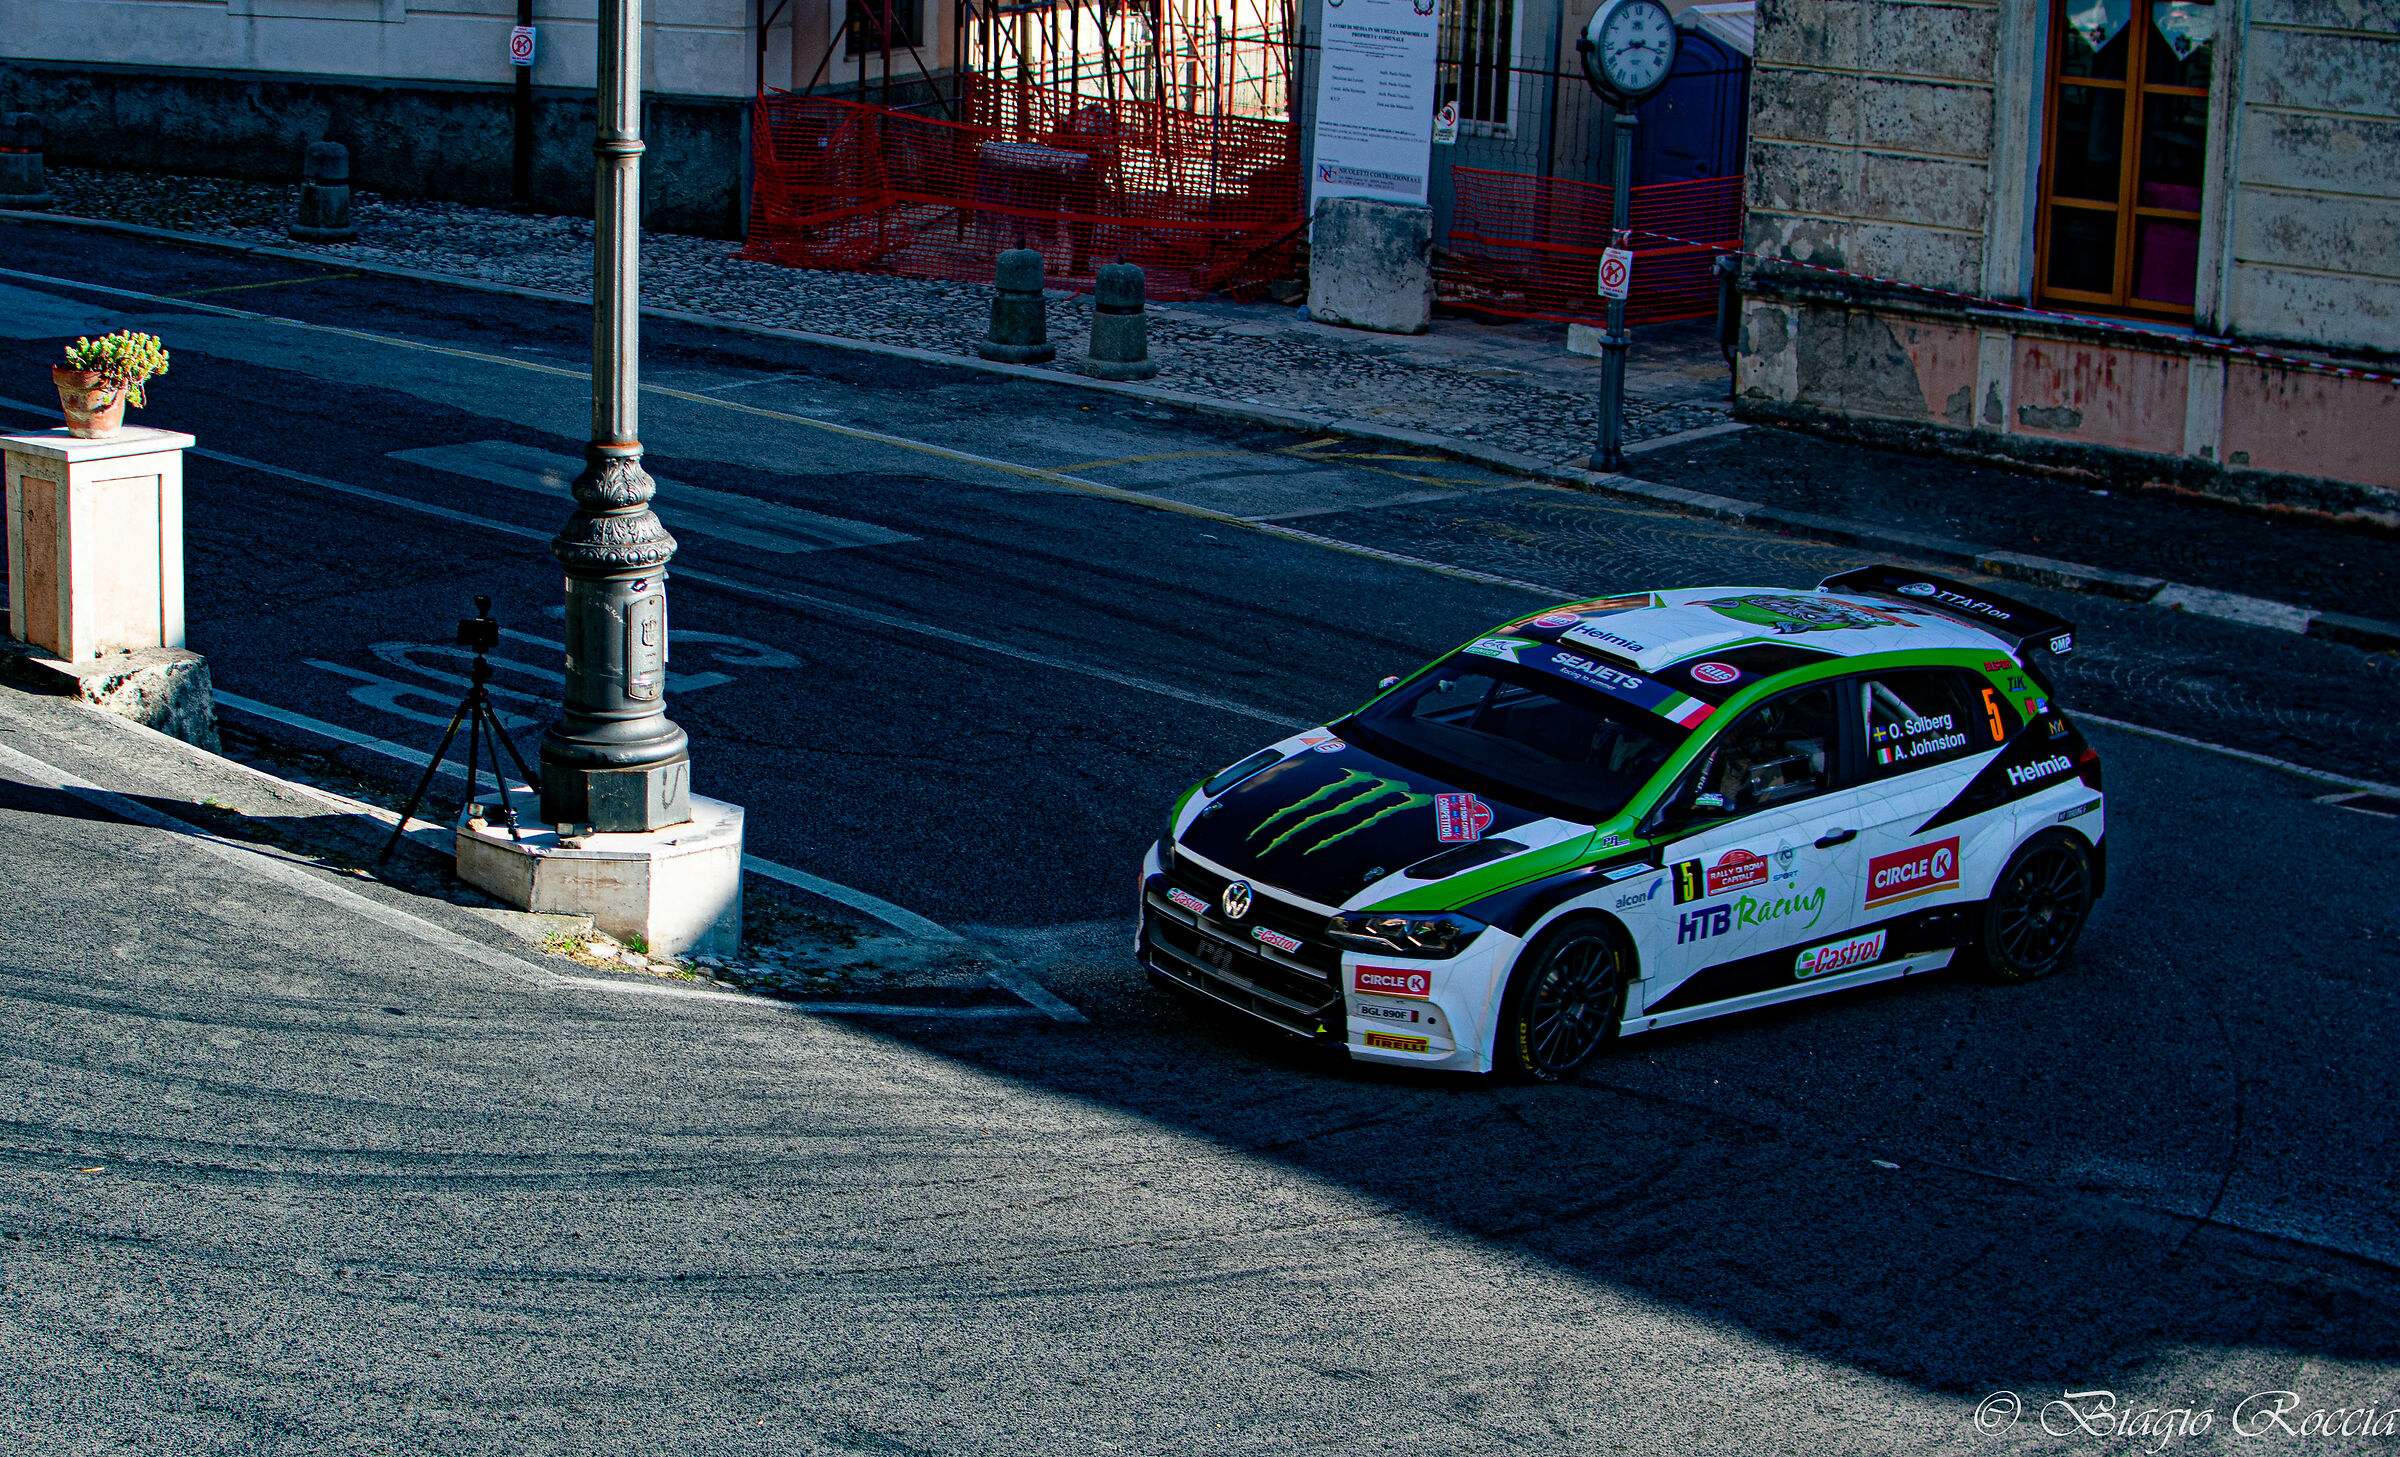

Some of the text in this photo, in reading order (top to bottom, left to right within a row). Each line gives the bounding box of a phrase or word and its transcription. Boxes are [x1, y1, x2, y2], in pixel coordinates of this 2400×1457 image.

[1573, 625, 1645, 653] Helmia
[2050, 636, 2072, 652] OMP
[1551, 652, 1643, 689] SEAJETS
[1560, 667, 1617, 692] Racing to summer
[1889, 713, 1953, 740] O. Solberg
[1981, 688, 2005, 742] 5
[1895, 732, 1967, 761] A. Johnston
[2007, 754, 2073, 786] Helmia
[1439, 797, 1452, 837] COMPETITOR
[1710, 868, 1734, 880] RALLY
[1744, 861, 1765, 873] ROMA
[1721, 871, 1755, 885] CAPITALE
[1772, 870, 1799, 882] SPORT
[1875, 848, 1952, 889] CIRCLE K
[1680, 862, 1694, 902] 5
[1174, 891, 1209, 913] Castrol
[1615, 893, 1647, 909] alcon
[1677, 882, 1827, 945] HTB Racing
[1260, 930, 1299, 952] Castrol
[1814, 935, 1881, 974] Castrol
[1360, 973, 1426, 992] CIRCLE K
[1361, 1006, 1407, 1019] BGL 890F
[1366, 1032, 1427, 1052] PIRELLI
